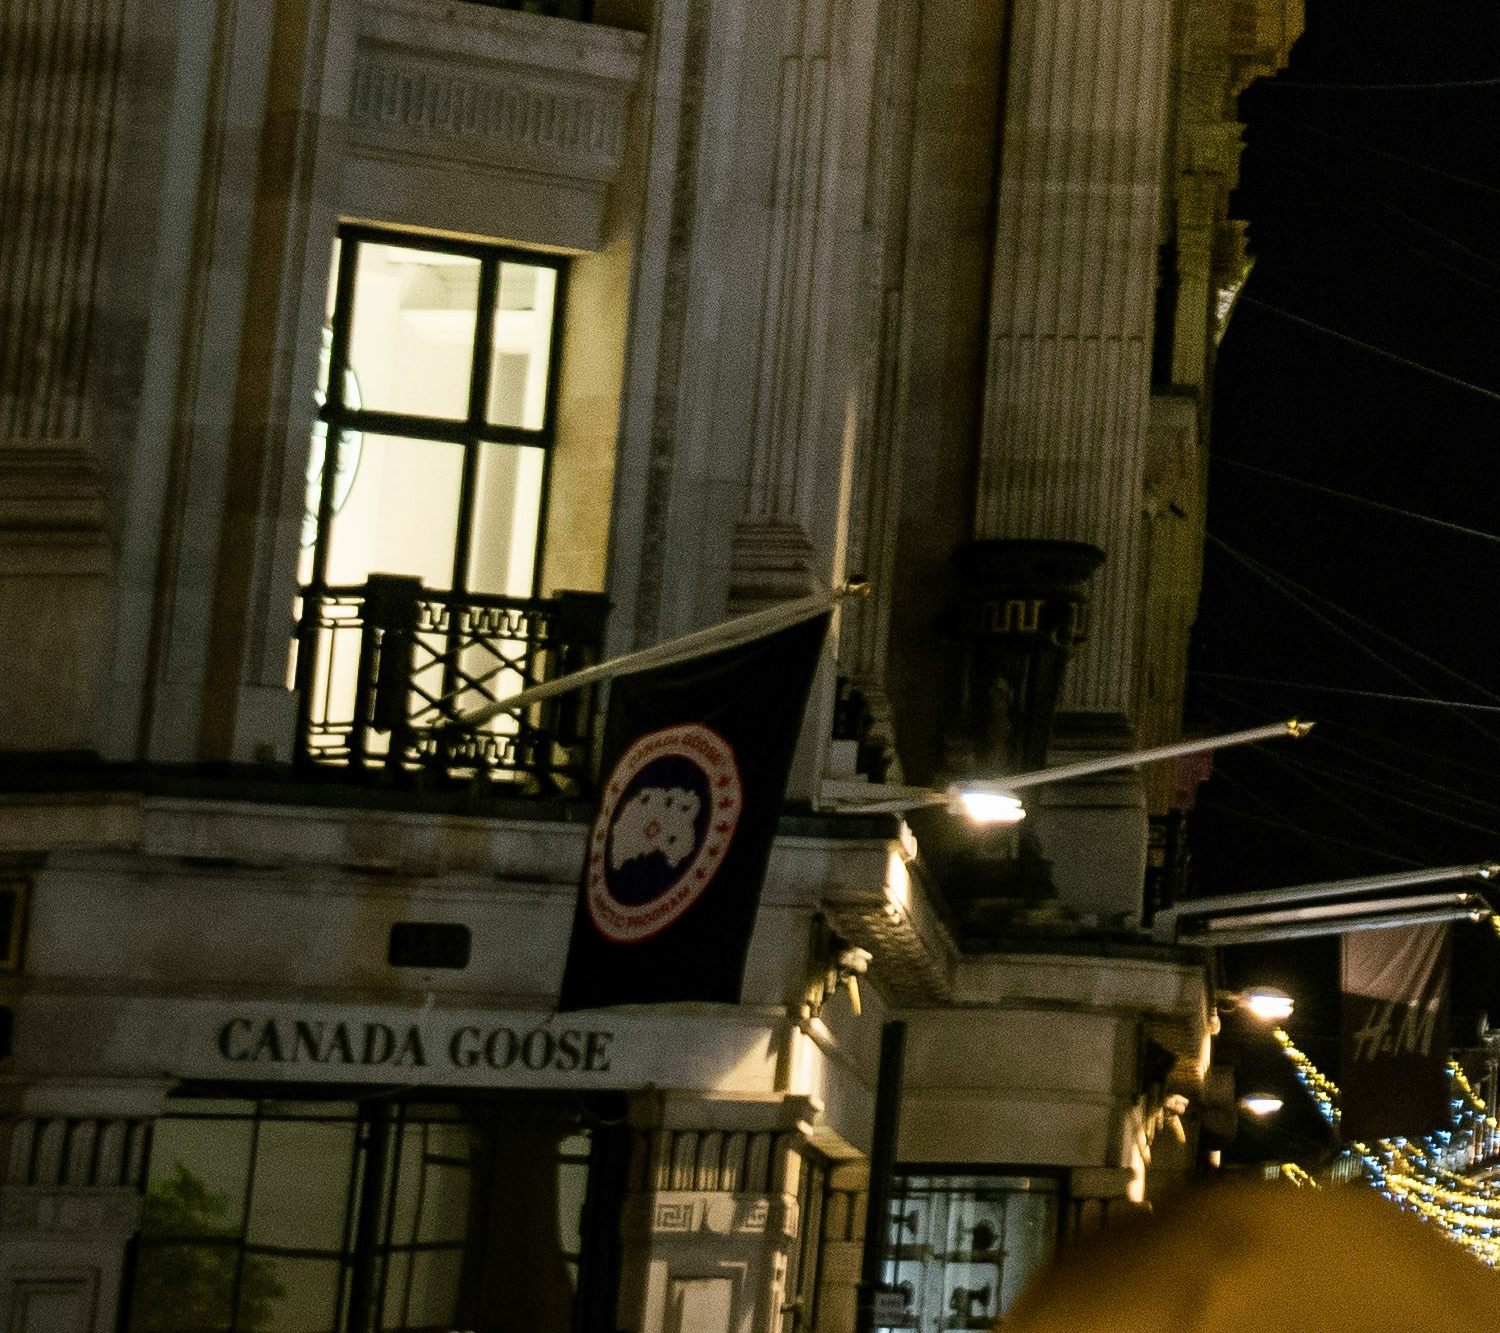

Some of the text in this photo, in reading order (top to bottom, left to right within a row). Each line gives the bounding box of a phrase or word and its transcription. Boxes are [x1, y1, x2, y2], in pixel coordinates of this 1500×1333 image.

[681, 733, 724, 766] GOOSE
[216, 1017, 614, 1071] CANADA GOOSE
[1352, 997, 1441, 1062] H&M
